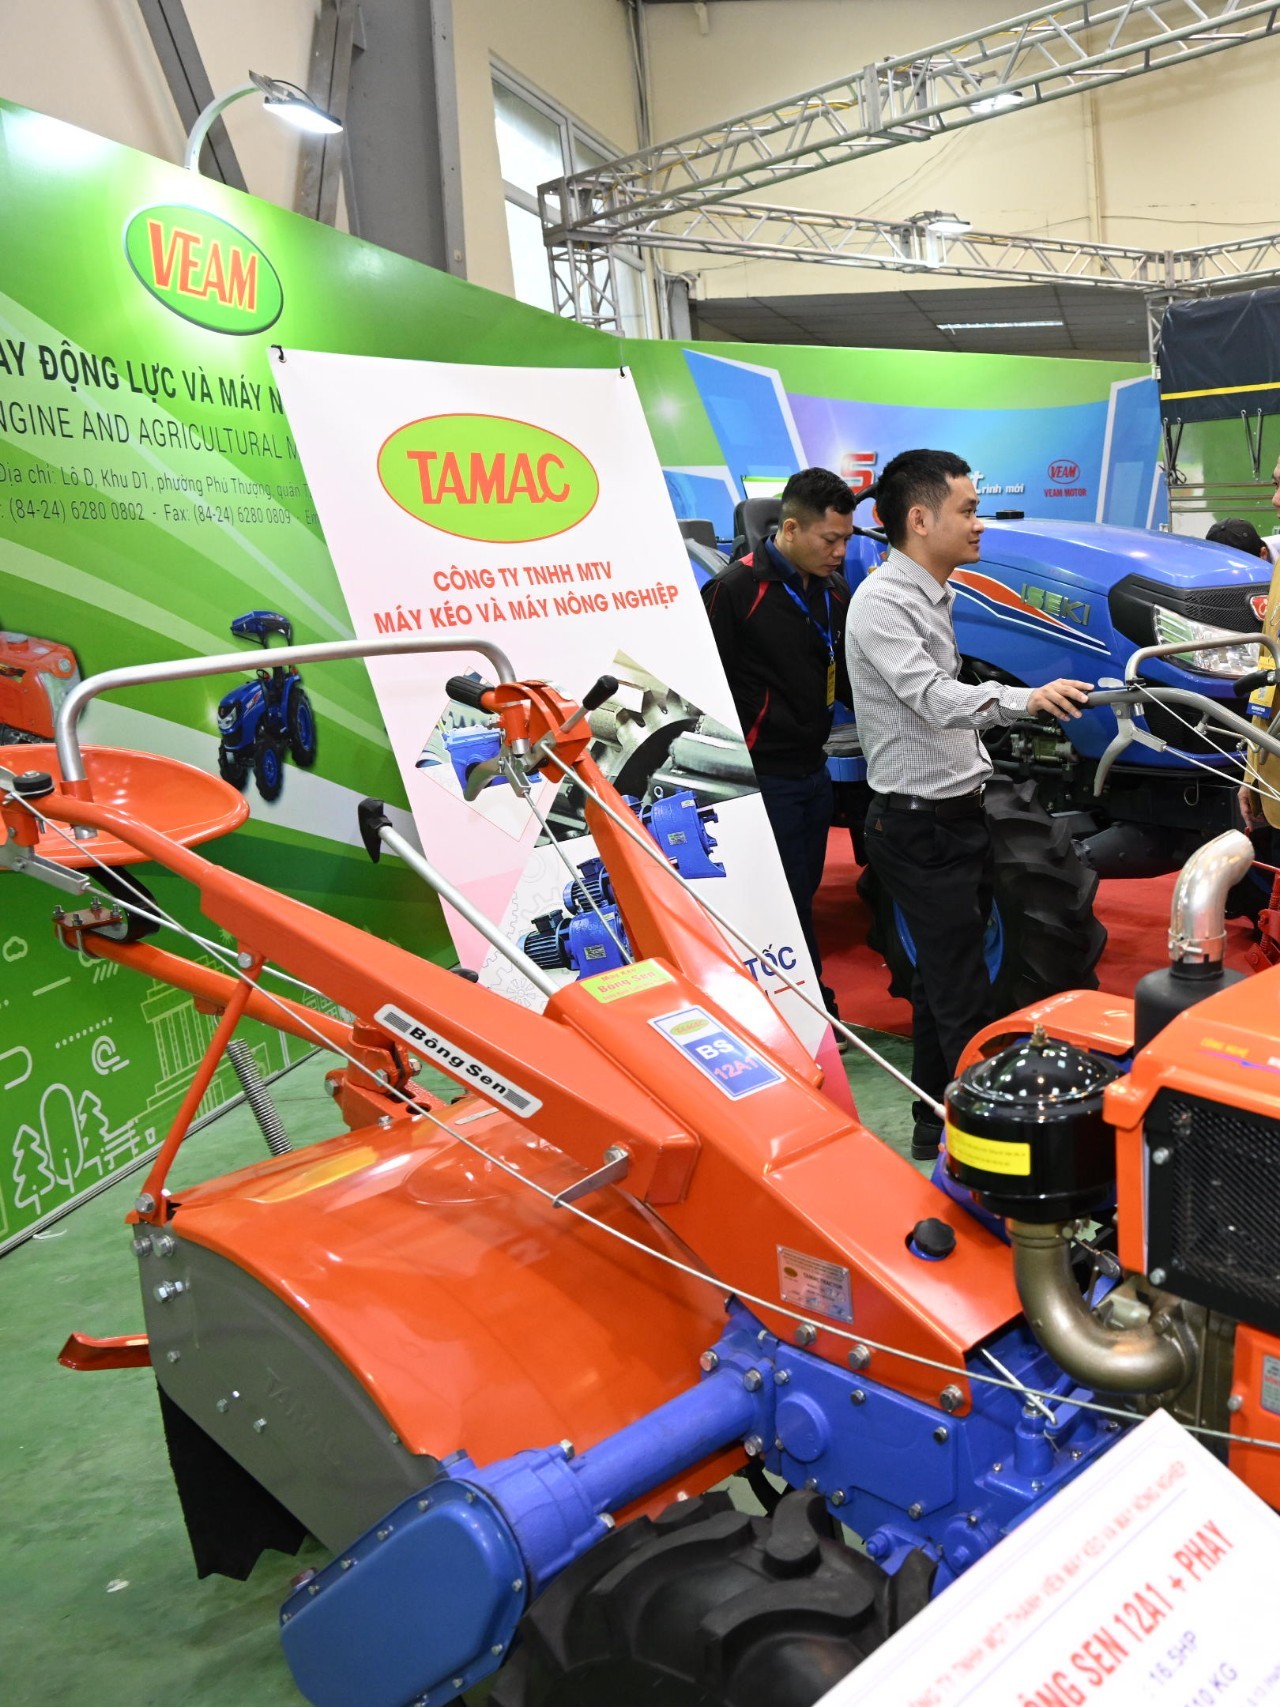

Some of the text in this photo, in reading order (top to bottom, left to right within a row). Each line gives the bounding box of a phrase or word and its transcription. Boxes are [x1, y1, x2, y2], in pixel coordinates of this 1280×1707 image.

[147, 218, 259, 313] VEAM
[38, 340, 119, 392] ĐỘNG
[126, 360, 176, 403] LỰC
[182, 366, 214, 404] VÀ
[218, 375, 261, 411] MÁY
[83, 411, 129, 443] AND
[139, 417, 282, 459] AGRICULTURAL
[61, 466, 79, 486] Lô
[101, 469, 128, 488] Khu
[157, 473, 203, 497] phường
[407, 450, 570, 504] TAMAC
[1050, 466, 1077, 478] VEAM
[10, 497, 66, 524] (84-24)
[71, 500, 107, 520] 6280
[111, 501, 145, 521] 0802
[164, 504, 190, 522] Fax:
[193, 504, 234, 525] (84-24)
[237, 507, 263, 523] 6280
[1044, 488, 1087, 498] VEAM MOTOR
[433, 561, 612, 592] CÔNG TY TNHH MTV
[373, 582, 679, 634] MÁY KÉO VÀ MÁY NÔNG NGHIỆP
[1020, 583, 1091, 626] ISEKI
[743, 944, 796, 981] TỐC
[409, 1027, 507, 1094] Bông Sen
[695, 1039, 734, 1060] BS
[714, 1055, 758, 1080] 12A1
[1070, 1626, 1129, 1688] SEN
[1113, 1582, 1174, 1643] 12A1
[1173, 1519, 1234, 1581] PHAY
[1209, 1661, 1238, 1693] KG
